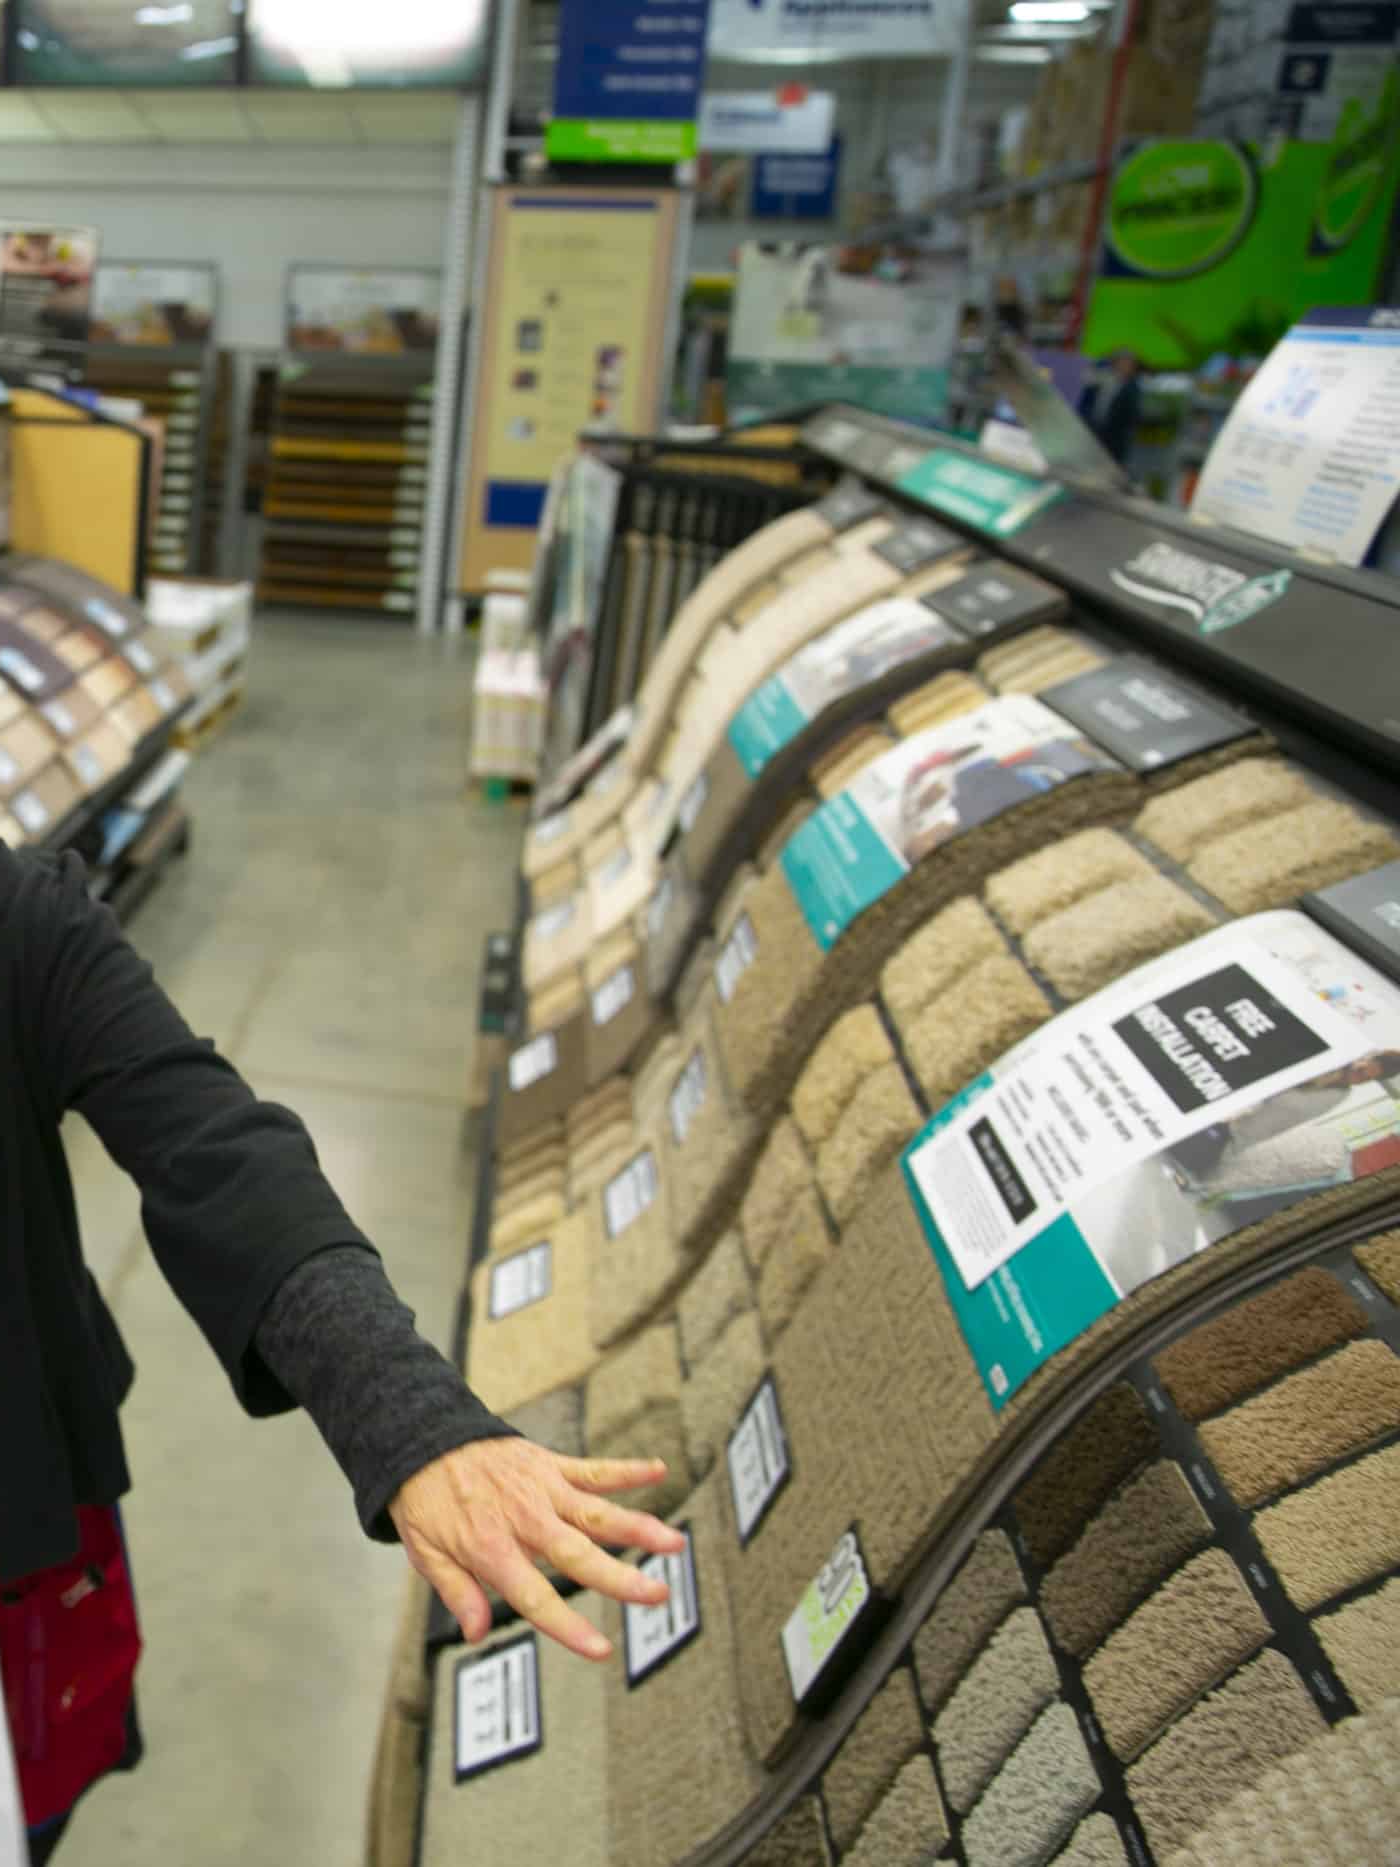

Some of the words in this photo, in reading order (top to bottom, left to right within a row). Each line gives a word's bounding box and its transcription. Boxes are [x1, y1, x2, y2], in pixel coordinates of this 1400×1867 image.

[1183, 1006, 1251, 1062] CARPET
[1224, 998, 1277, 1039] FREE
[1132, 1001, 1233, 1101] INSTALLATION
